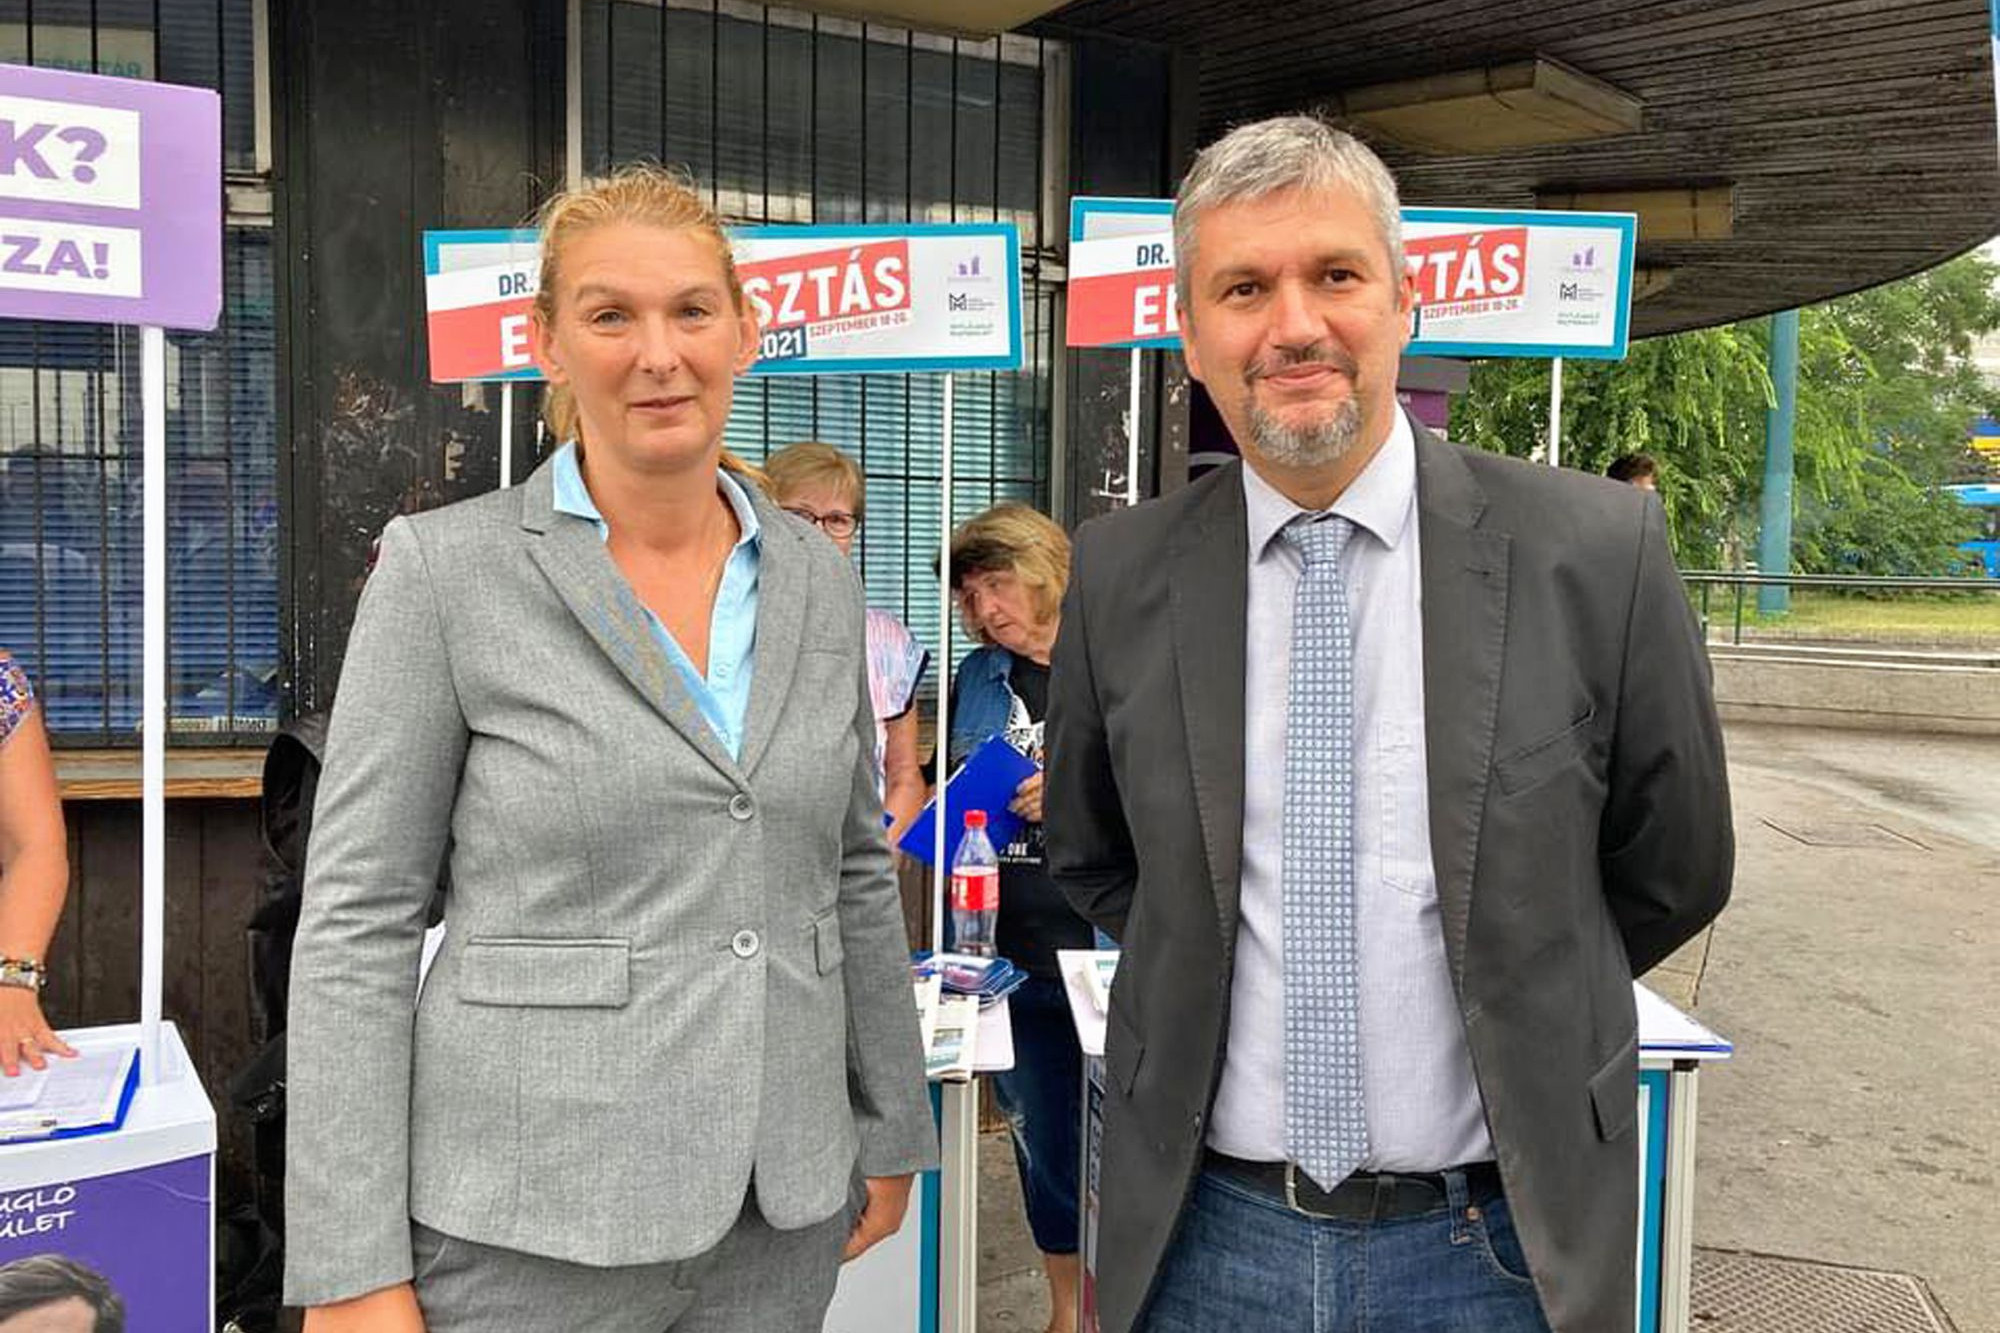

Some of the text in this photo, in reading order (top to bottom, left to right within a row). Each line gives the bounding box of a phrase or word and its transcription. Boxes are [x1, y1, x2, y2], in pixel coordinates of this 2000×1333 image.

[2, 234, 109, 280] ZA!
[1136, 243, 1170, 267] DR.
[499, 272, 534, 296] DR.
[808, 316, 878, 338] SZEPTEMBER
